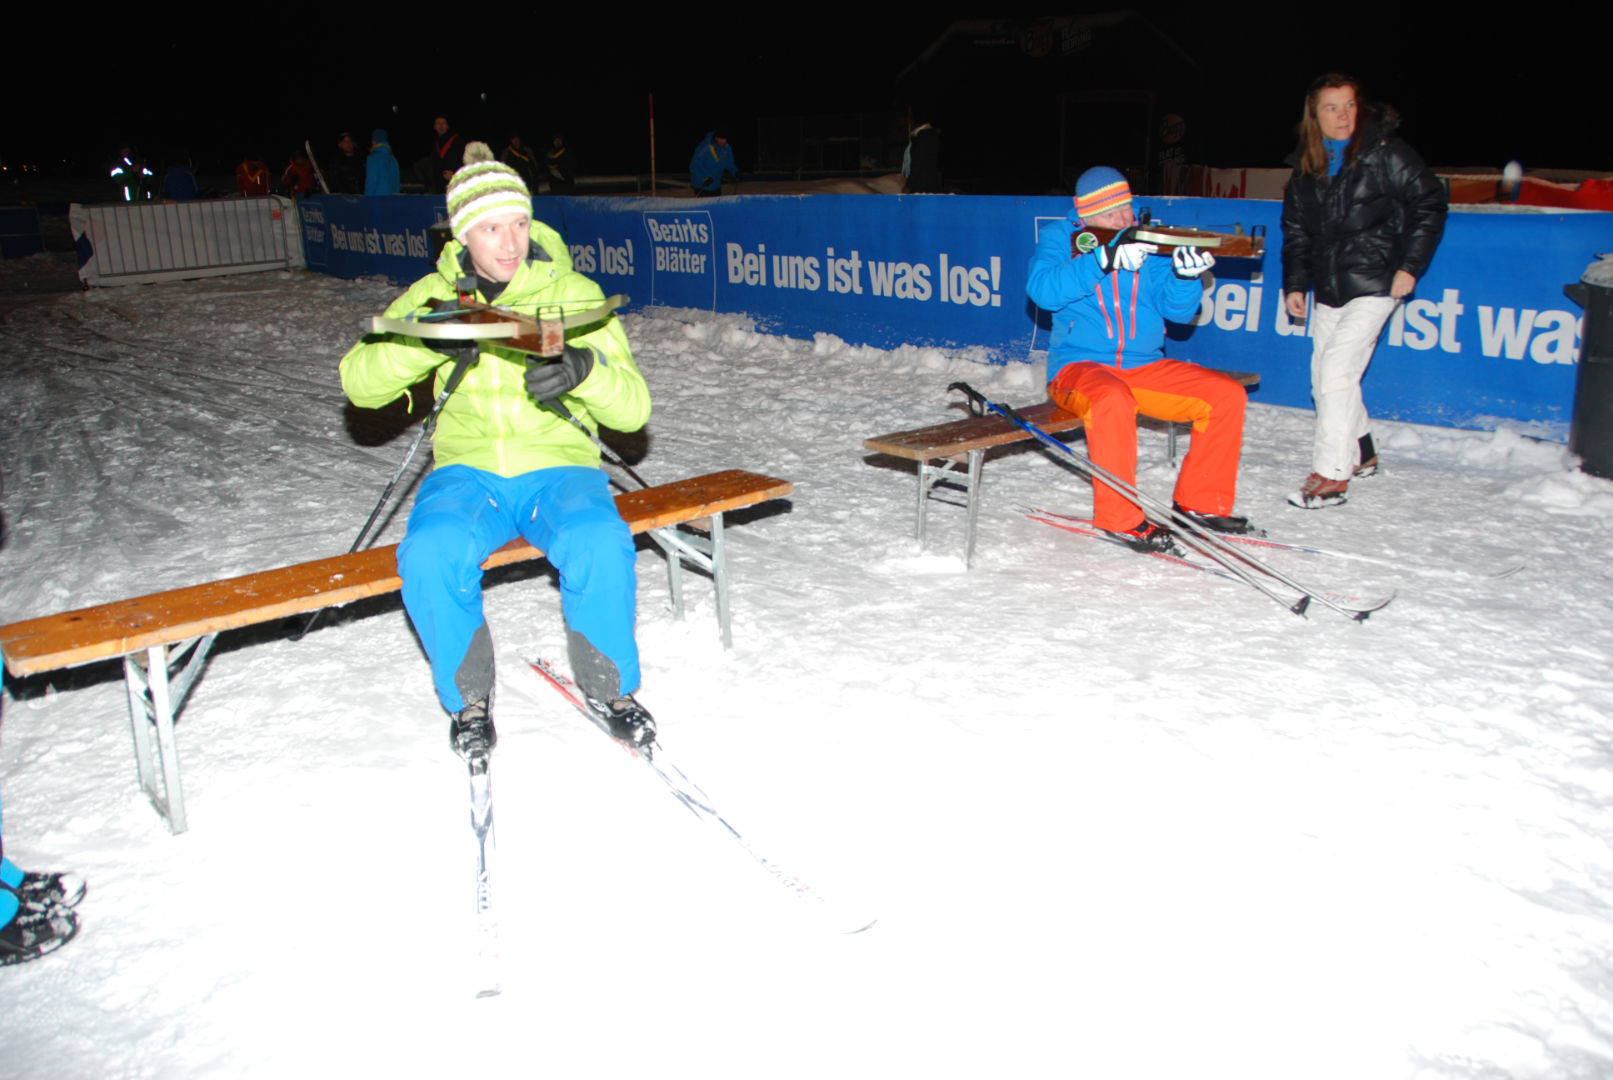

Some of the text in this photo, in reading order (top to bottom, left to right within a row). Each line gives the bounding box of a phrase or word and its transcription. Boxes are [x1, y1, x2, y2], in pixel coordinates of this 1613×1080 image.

[331, 224, 429, 258] Bei uns ist was los!
[647, 218, 709, 244] Bezirks
[598, 238, 635, 276] los!
[655, 246, 707, 275] Blätter
[726, 242, 1002, 307] Bei uns ist was los!
